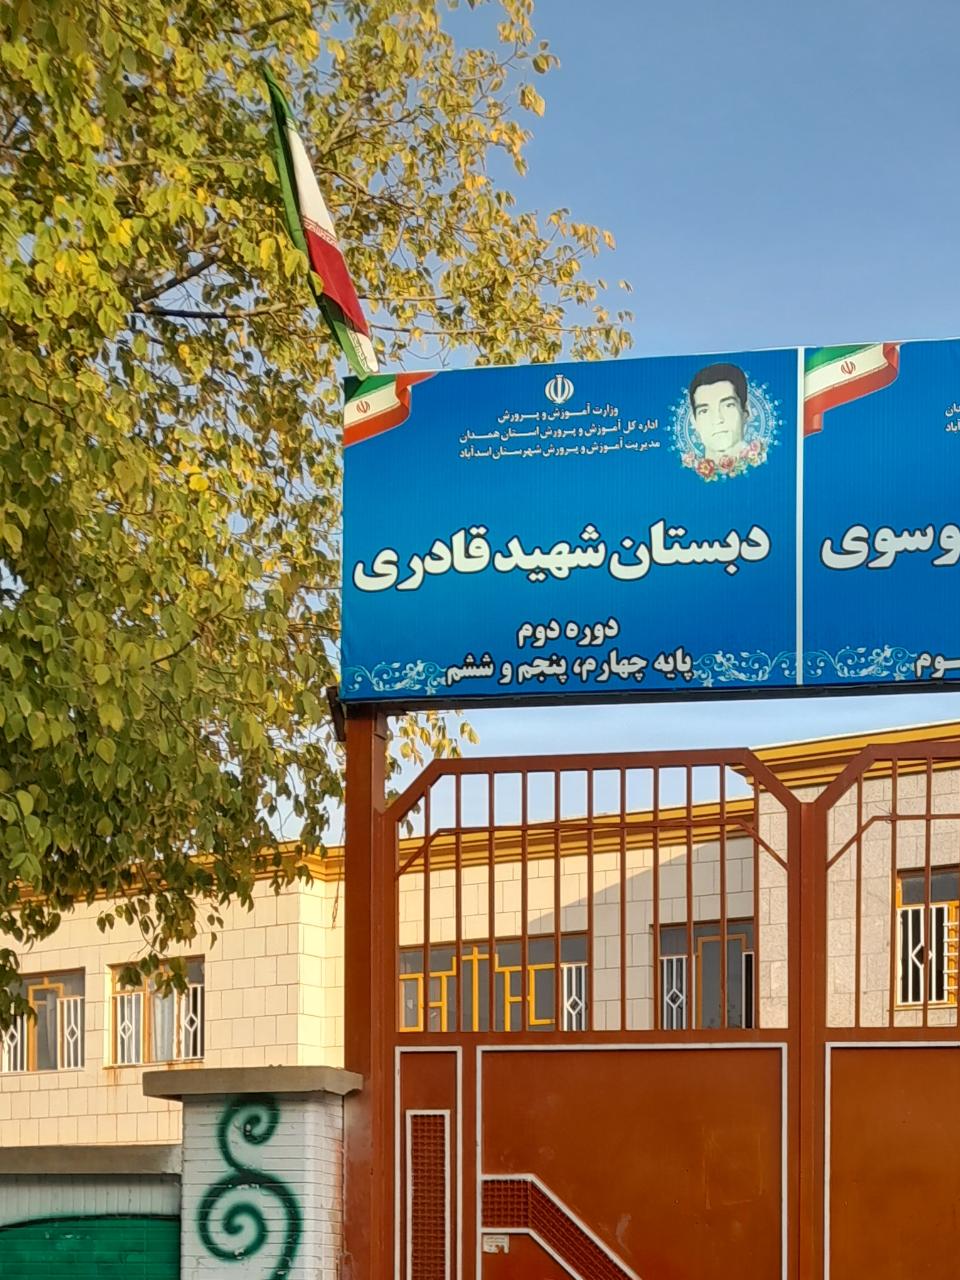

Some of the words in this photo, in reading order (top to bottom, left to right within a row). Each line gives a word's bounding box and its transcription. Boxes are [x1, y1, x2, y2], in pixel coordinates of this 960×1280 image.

[497, 410, 540, 423] پرورش
[549, 402, 590, 420] آموزش
[592, 403, 619, 417] وزارت
[500, 426, 539, 441] استان
[540, 426, 576, 439] پرورش
[584, 420, 621, 437] آموزش
[623, 420, 637, 434] کل
[638, 419, 659, 433] اداره
[459, 429, 500, 443] همدان
[493, 443, 542, 460] شهرستان
[543, 444, 579, 457] پرورش
[586, 436, 623, 454] آموزش
[624, 440, 661, 453] مدیریت
[493, 523, 606, 582] شهید
[609, 517, 770, 581] دبستان
[352, 525, 491, 591] قادری
[517, 617, 560, 647] دوم
[565, 616, 620, 646] دوره
[444, 653, 495, 686] ششم
[498, 663, 513, 684] و
[516, 652, 568, 684] پنجم
[652, 648, 694, 684] پایه
